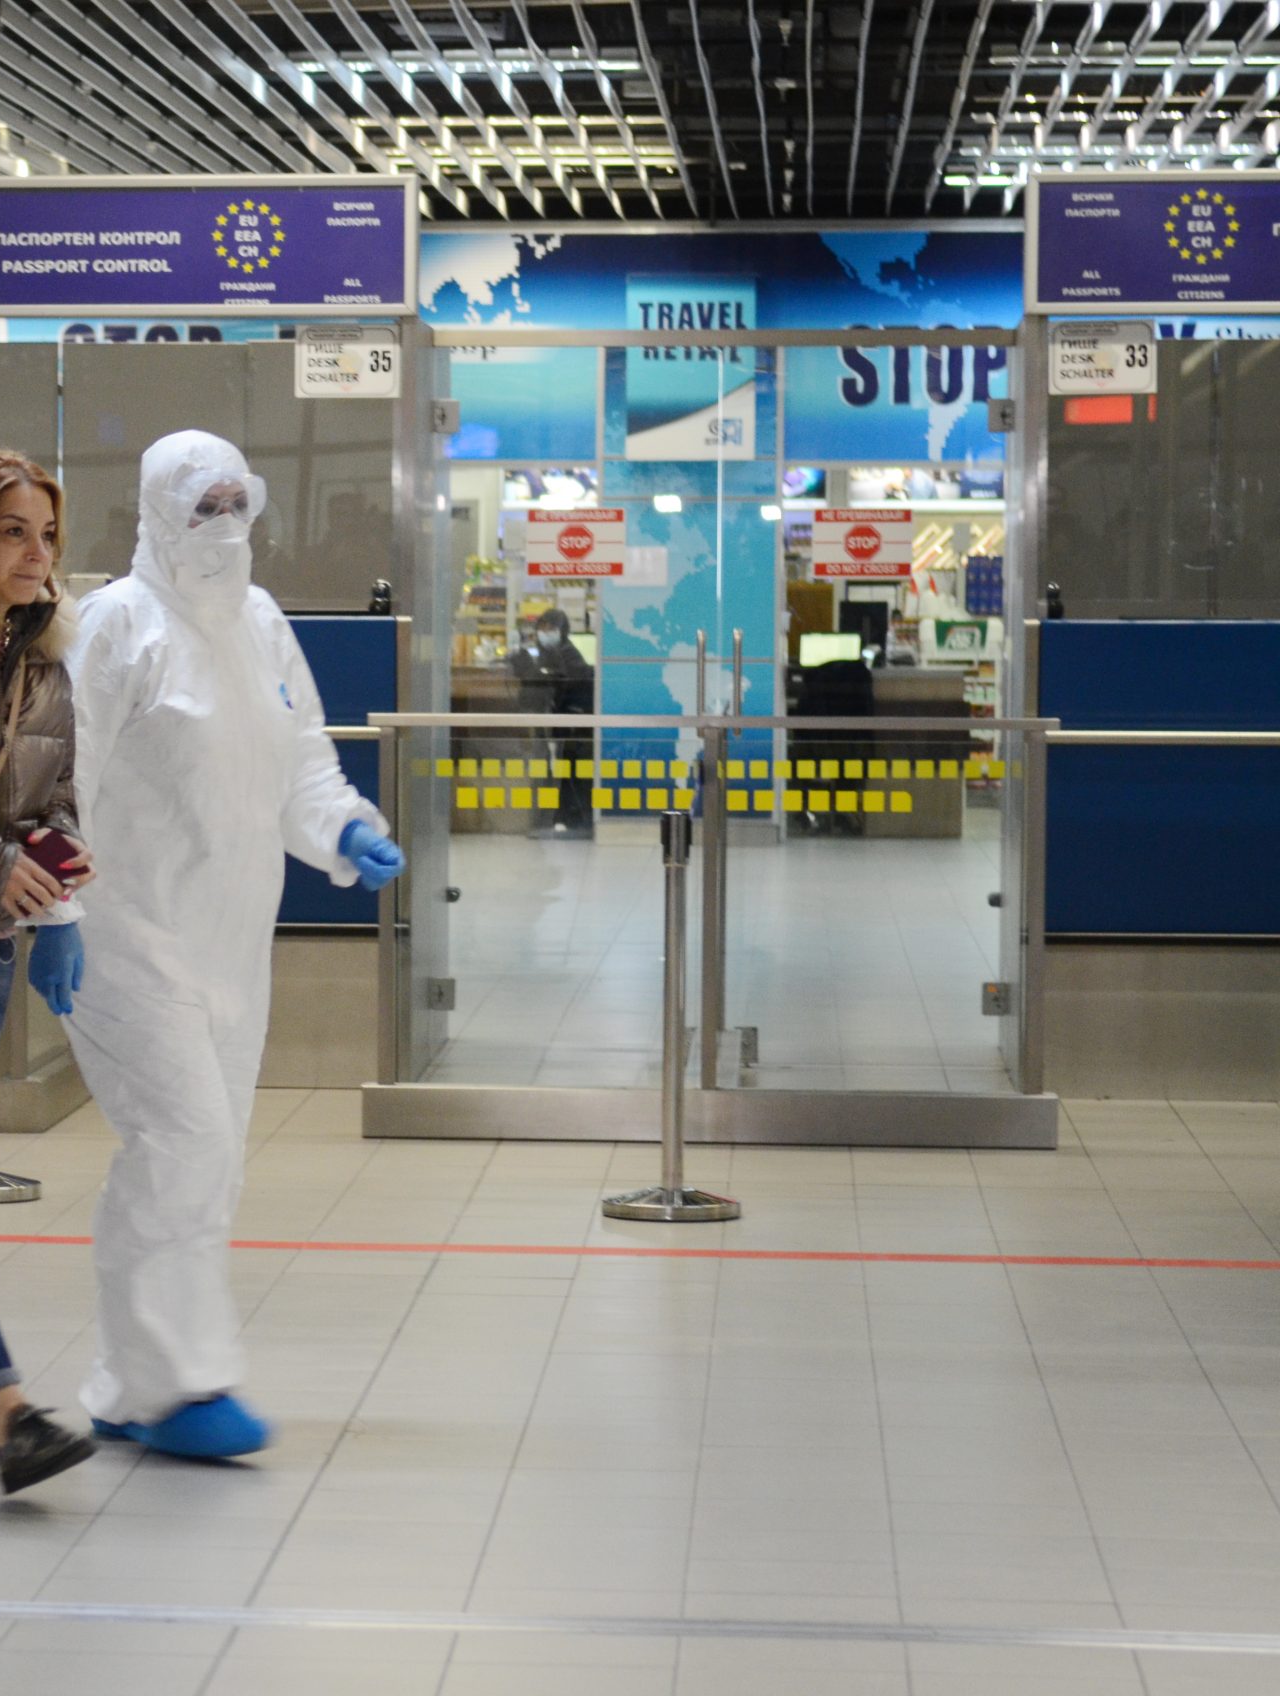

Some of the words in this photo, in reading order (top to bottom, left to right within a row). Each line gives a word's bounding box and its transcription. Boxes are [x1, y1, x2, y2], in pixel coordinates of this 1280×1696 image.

[1071, 192, 1114, 202] ВСИЧКИ
[332, 201, 375, 211] ВСИЧКИ
[1192, 204, 1212, 217] EU
[1065, 208, 1120, 218] ПАСПОРТИ
[238, 214, 259, 227] EU
[326, 216, 381, 227] ПАСПОРТИ
[1187, 220, 1215, 232] EEA
[99, 231, 182, 246] КОНТРОЛ
[234, 229, 262, 242] EEA
[1191, 236, 1213, 248] CH
[237, 245, 259, 257] CH
[1, 259, 90, 274] PASSPORT
[93, 258, 173, 273] CONTROL
[1082, 269, 1101, 280] ALL
[343, 278, 363, 288] ALL
[1062, 286, 1121, 297] PASSPORTS
[1177, 290, 1225, 300] CITIZENS
[323, 294, 382, 304] PASSPORTS
[638, 302, 747, 331] TRAVEL
[369, 349, 392, 373] 35
[1061, 354, 1096, 364] DESK
[1126, 343, 1149, 368] 33
[307, 357, 340, 368] DESK
[840, 324, 1008, 407] STOP
[306, 372, 360, 383] SCHALTER
[1060, 368, 1115, 379] SCHALTER
[561, 536, 591, 549] STOP
[848, 536, 878, 549] STOP
[539, 563, 554, 574] DO
[556, 563, 574, 574] NOT
[826, 563, 841, 574] DO
[842, 563, 861, 574] NOT
